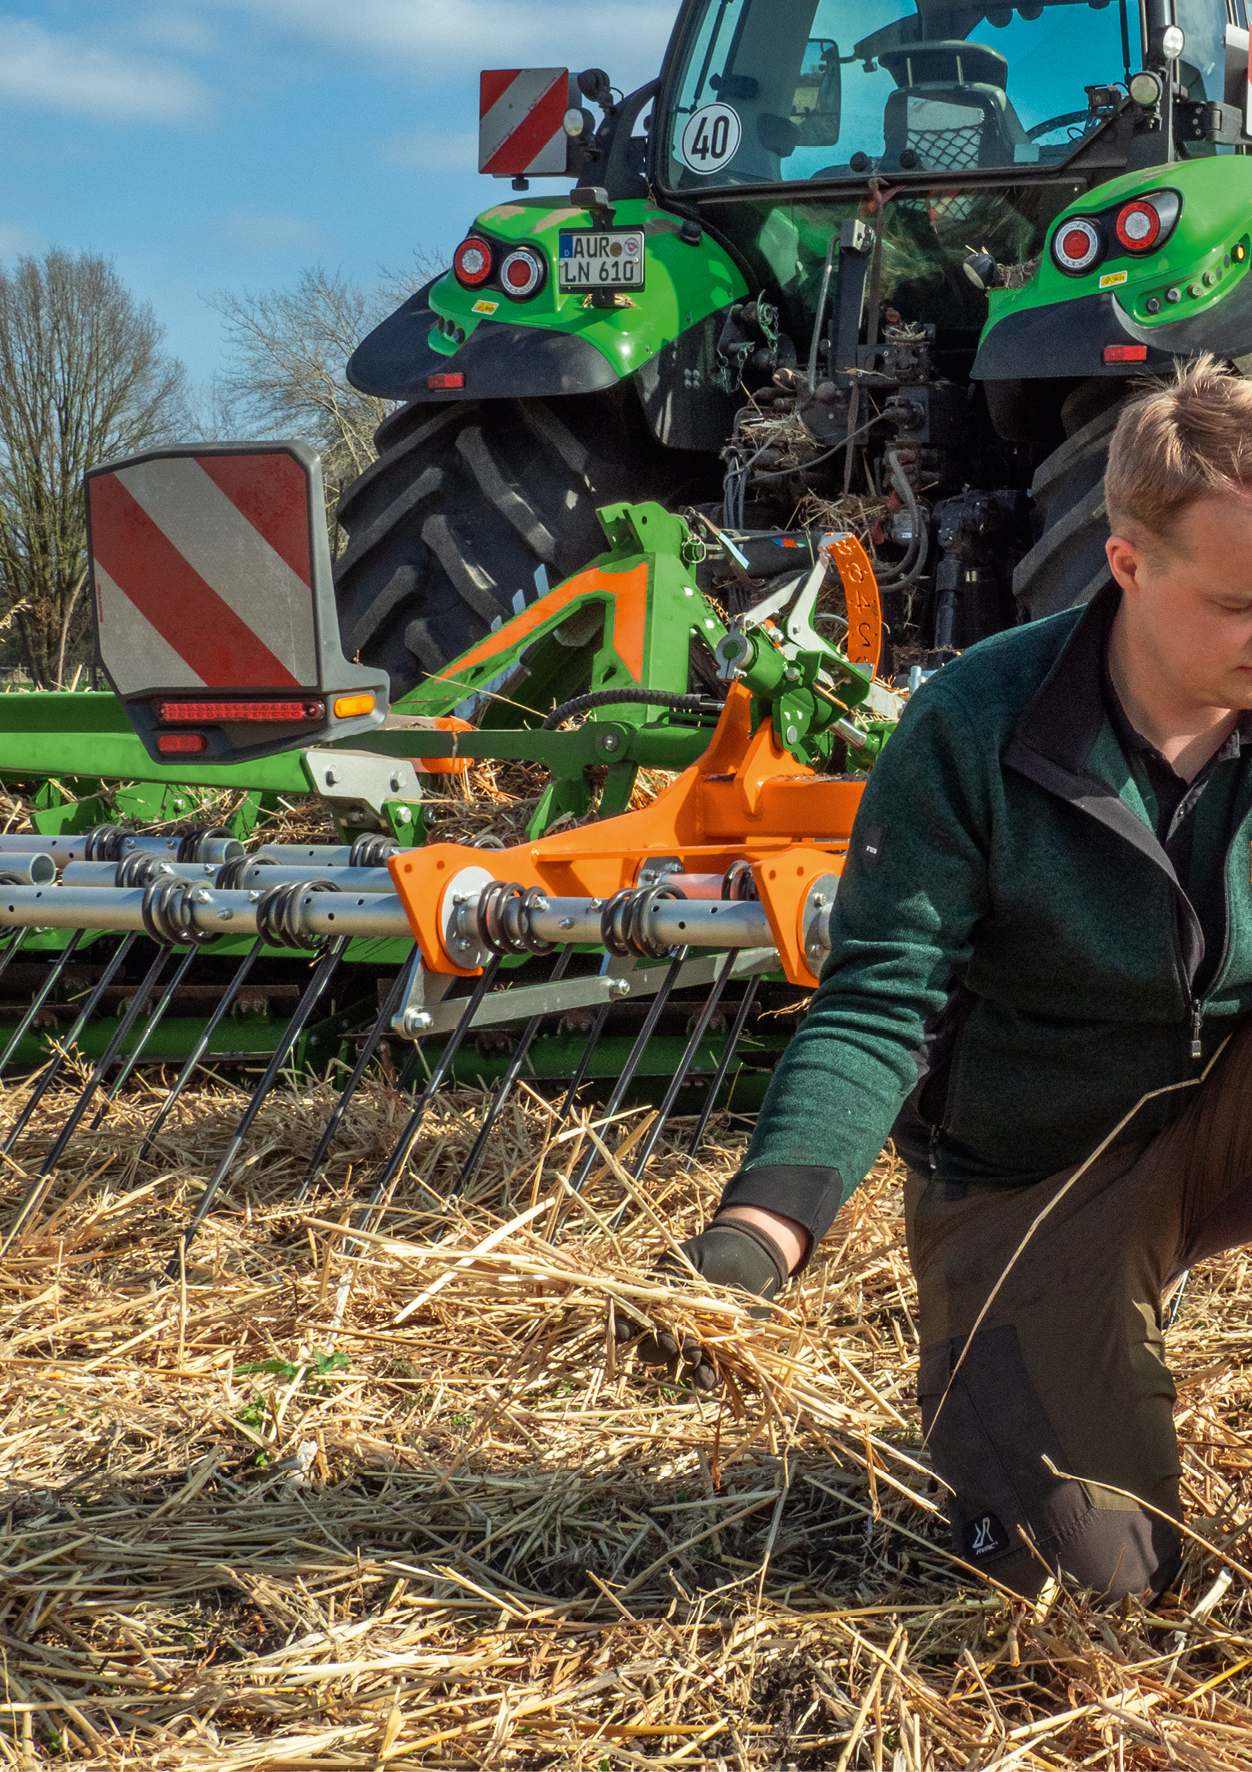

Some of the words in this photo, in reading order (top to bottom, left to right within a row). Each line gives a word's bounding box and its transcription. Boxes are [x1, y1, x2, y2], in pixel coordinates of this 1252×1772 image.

[691, 115, 730, 161] 40
[573, 236, 610, 258] AUR
[565, 262, 590, 282] LN
[598, 261, 634, 282] 610
